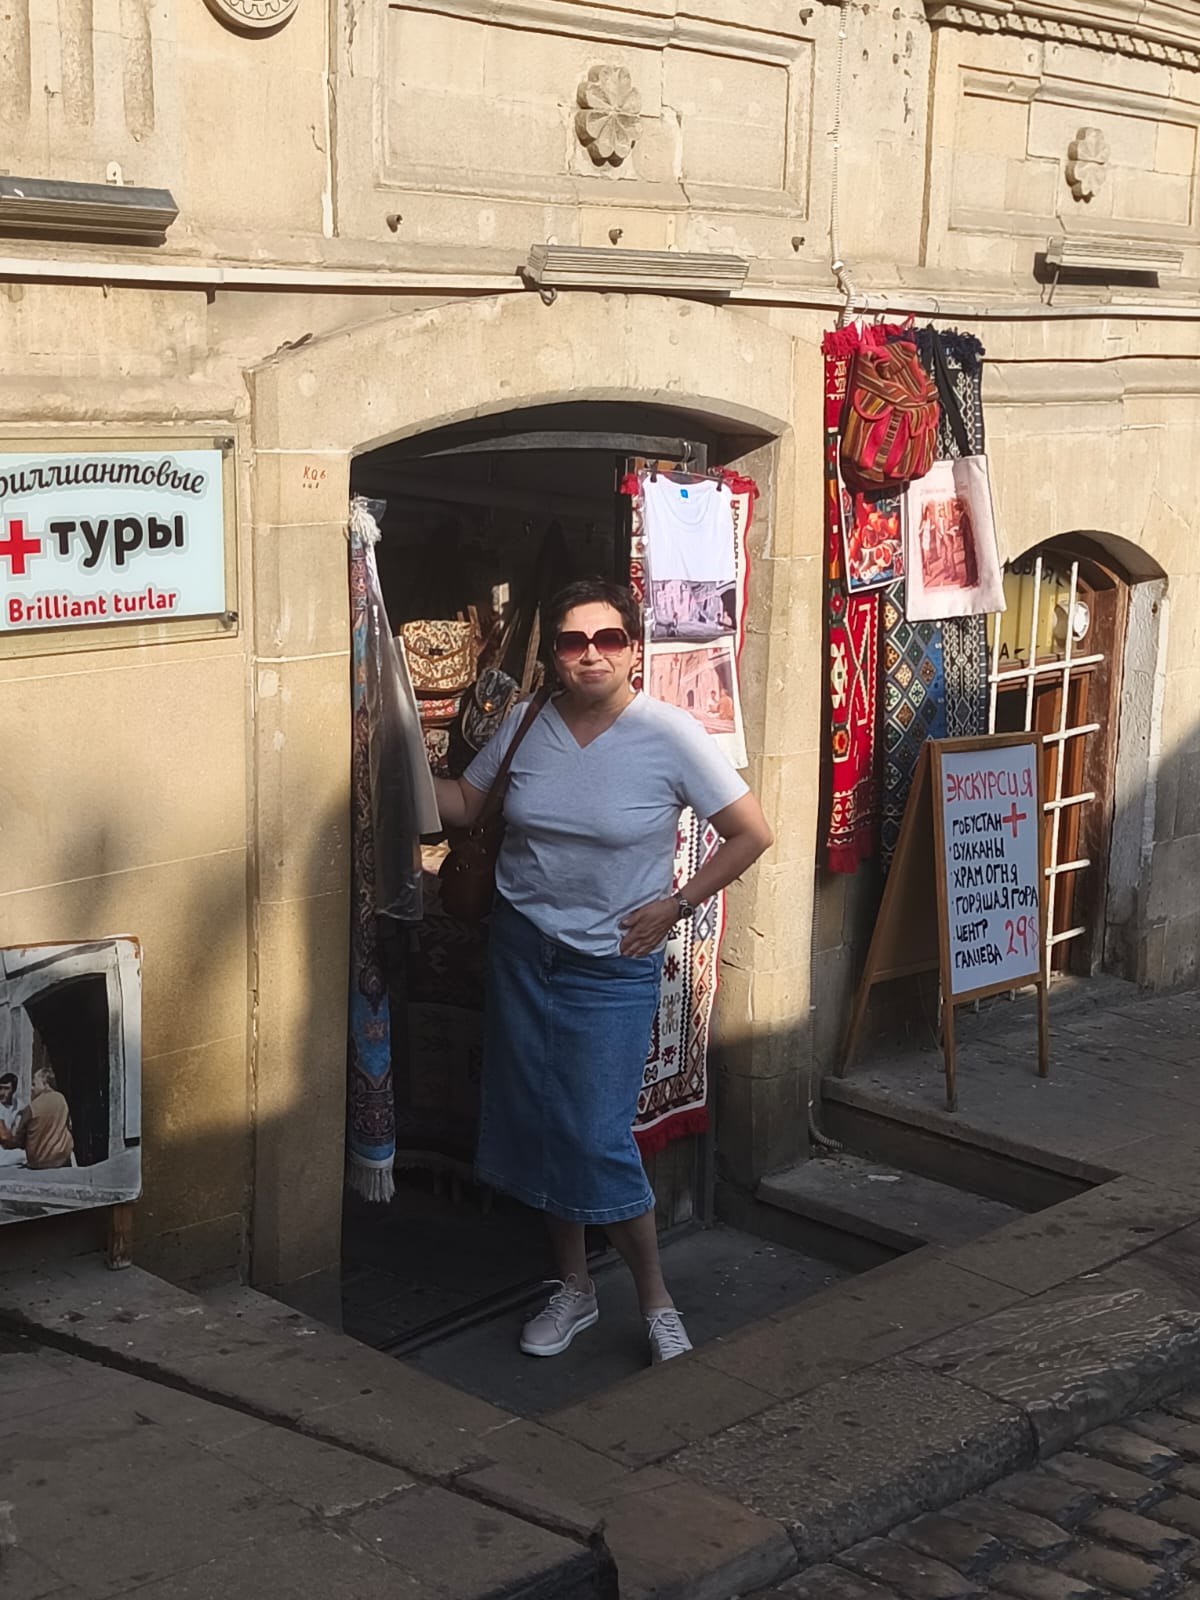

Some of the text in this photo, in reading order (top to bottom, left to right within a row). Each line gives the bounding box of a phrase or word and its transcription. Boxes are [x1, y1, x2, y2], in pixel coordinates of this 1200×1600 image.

[50, 514, 185, 568] туры
[8, 587, 177, 623] Brilliant turlar
[946, 767, 1034, 803] ЭКСКУРСИЯ
[952, 811, 1002, 837] ГОБУСТАН
[952, 837, 1005, 861] ВУЛКАНЫ
[953, 863, 1019, 889] ХРАМ ОГНЯ
[1011, 885, 1039, 910] ГОРА
[955, 918, 989, 943] ЦЕНТР
